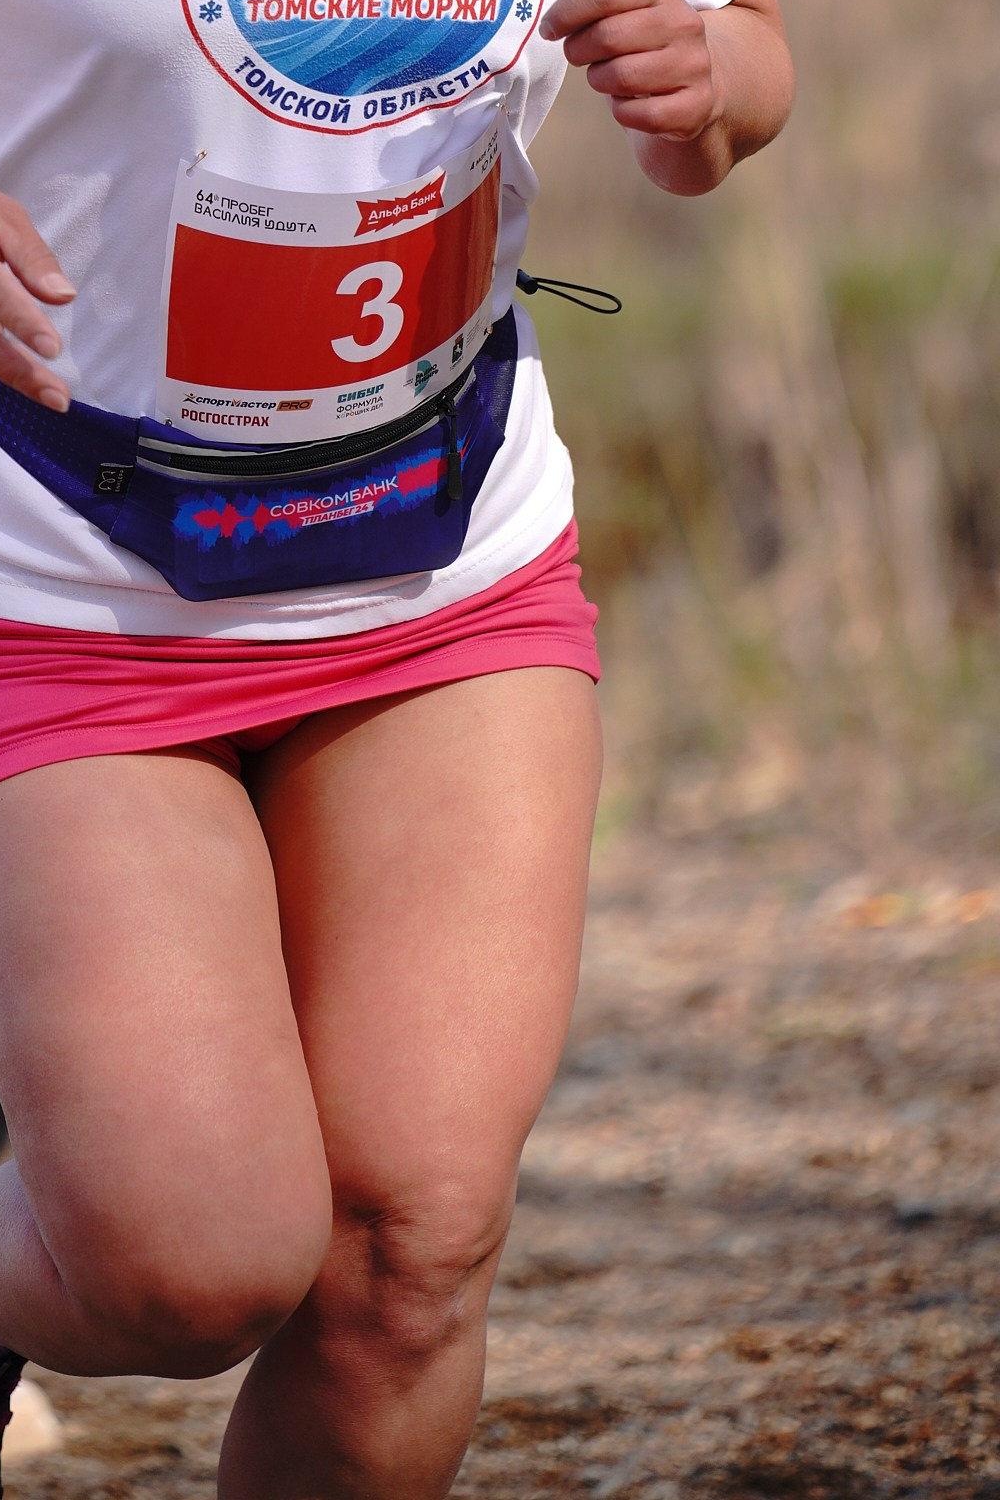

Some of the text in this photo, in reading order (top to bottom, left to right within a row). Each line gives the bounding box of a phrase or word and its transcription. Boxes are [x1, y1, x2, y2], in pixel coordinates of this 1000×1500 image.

[234, 56, 491, 124] ТОМСКОЙ ОБЛАСТИ
[194, 202, 260, 228] ВАСИЛИЯ
[221, 197, 274, 217] ПРОБЕГ
[368, 190, 437, 222] Альфа Банк
[330, 260, 405, 363] 3
[336, 395, 384, 413] ФОРМУЛА
[337, 383, 385, 404] СИБУР
[279, 401, 311, 410] PRO
[181, 408, 270, 427] РОСГОССТРАХ
[270, 475, 399, 518] СОВКОМБАНК
